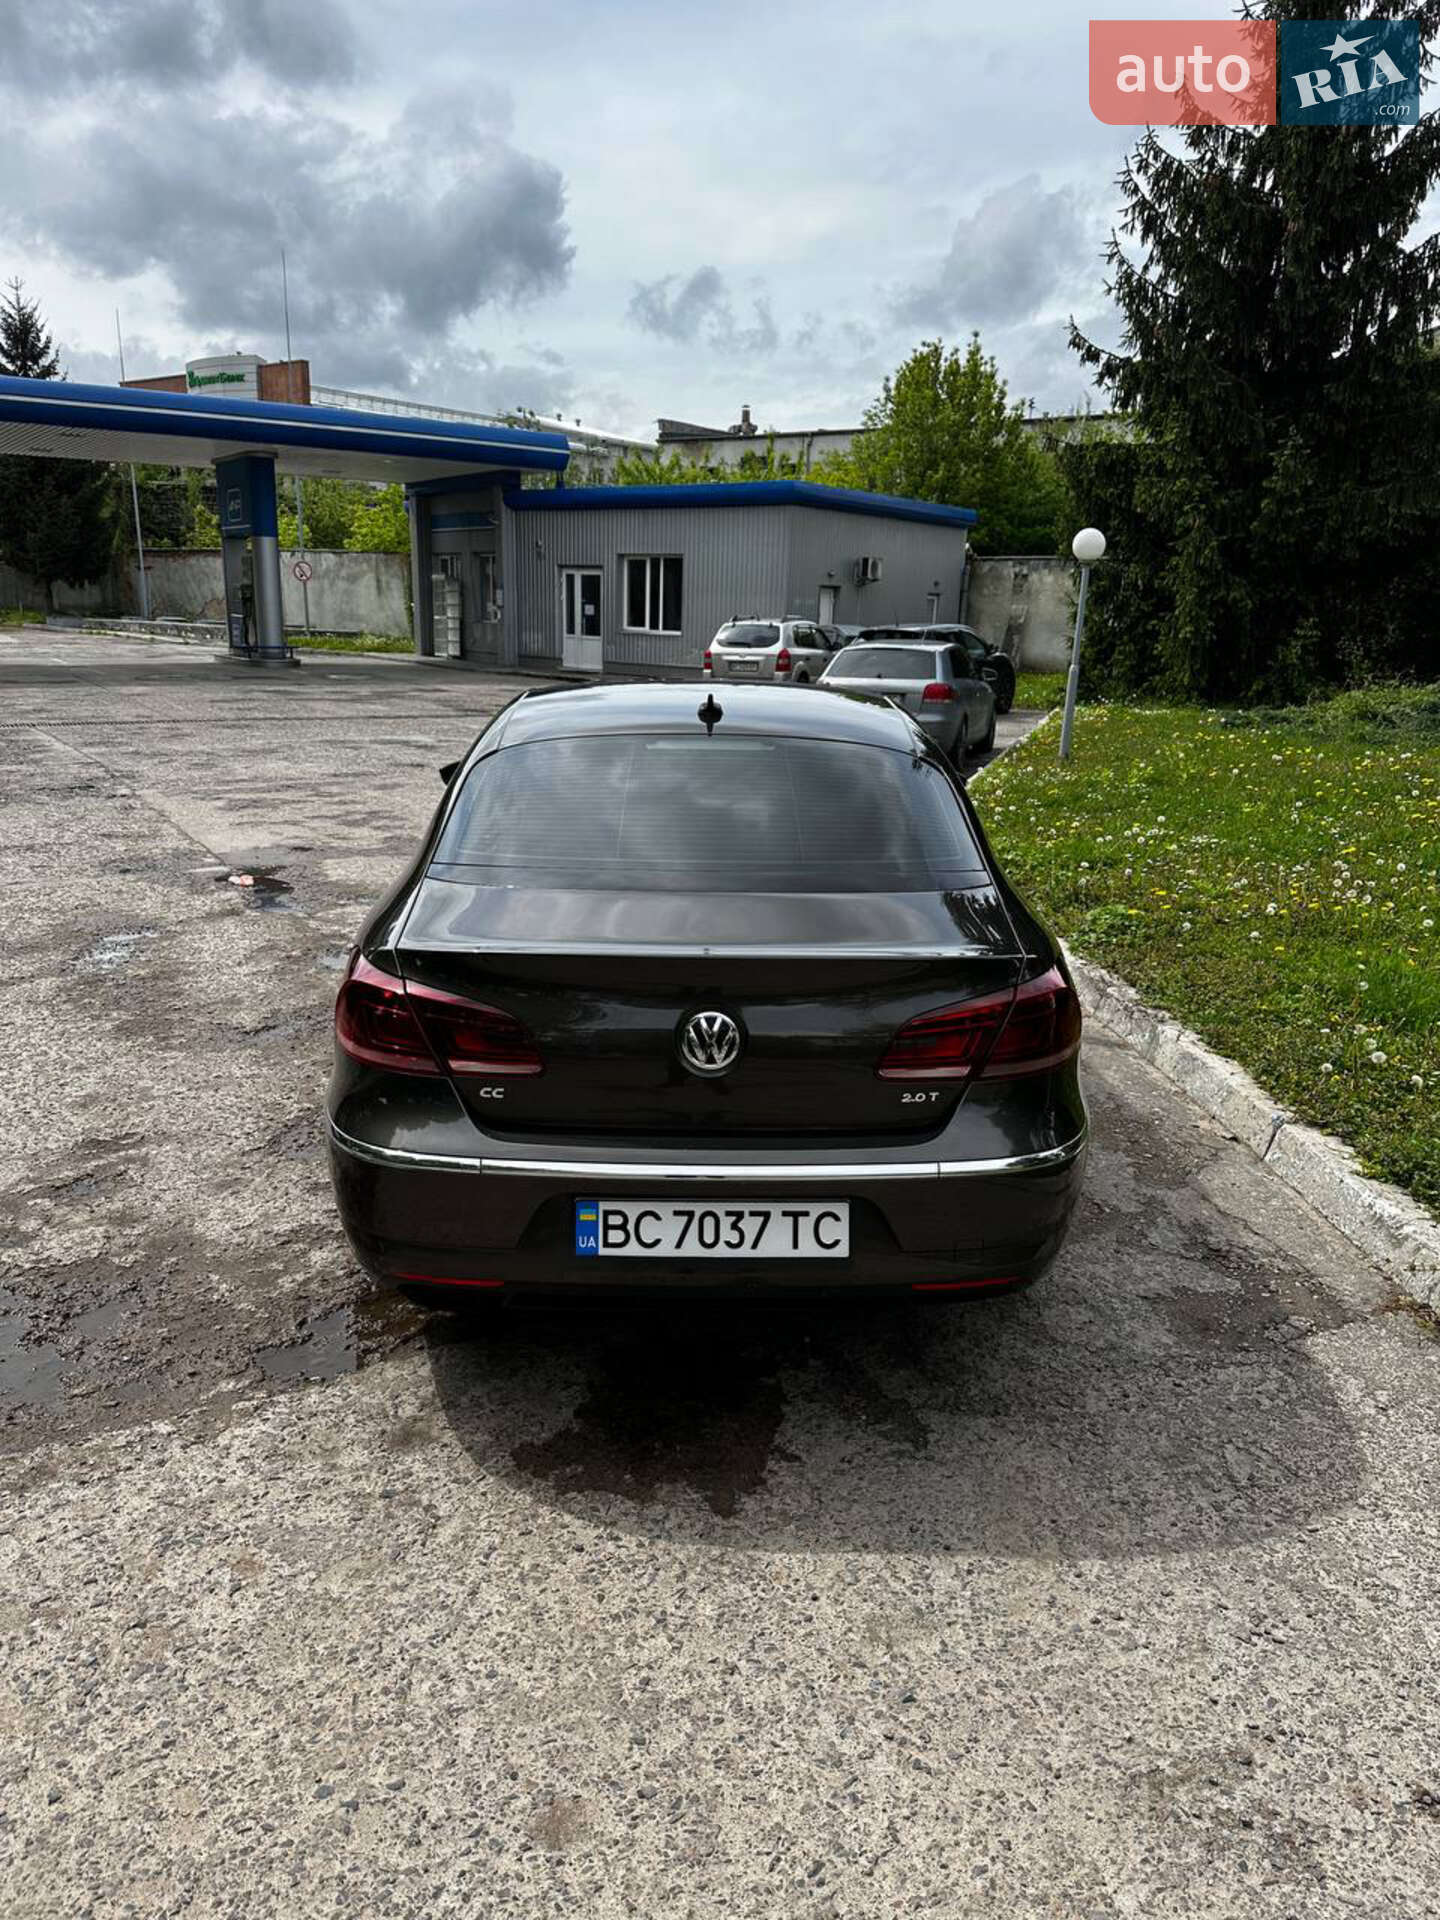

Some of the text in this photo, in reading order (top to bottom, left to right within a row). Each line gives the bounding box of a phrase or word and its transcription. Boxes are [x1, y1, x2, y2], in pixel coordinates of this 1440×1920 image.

[480, 1087, 504, 1098] CC
[602, 1209, 842, 1249] BC 7037 TC
[578, 1235, 597, 1248] UA
